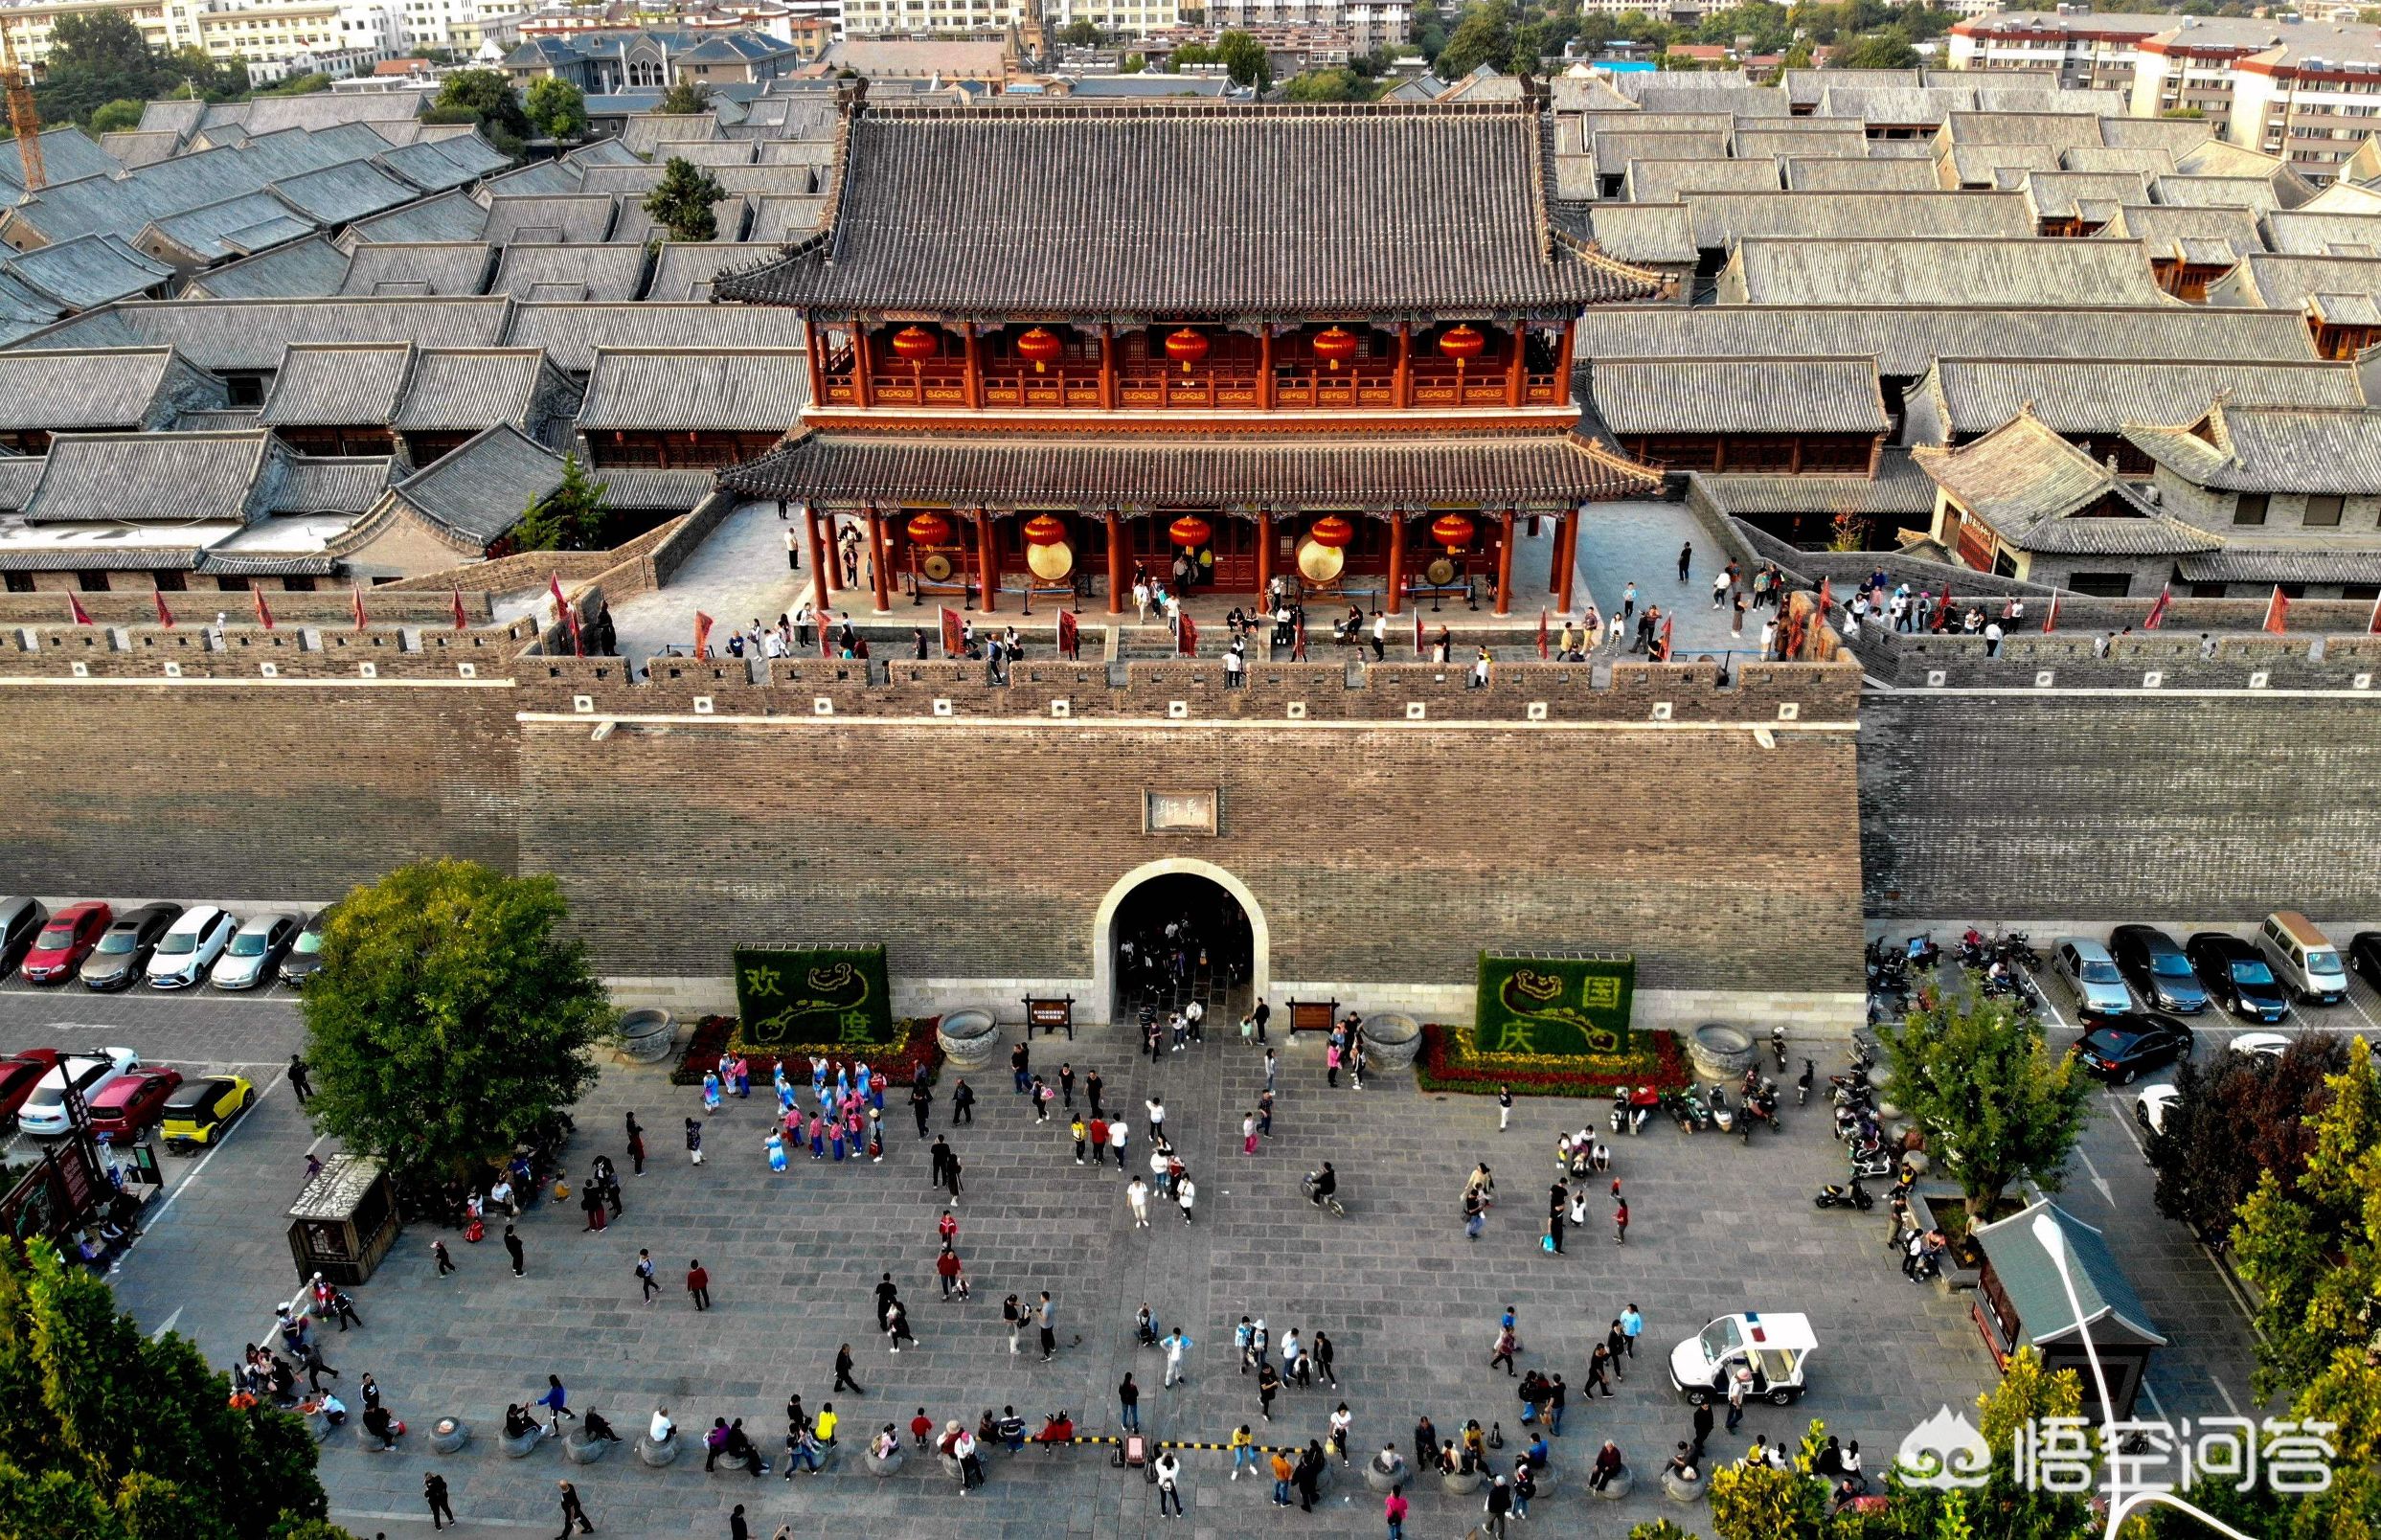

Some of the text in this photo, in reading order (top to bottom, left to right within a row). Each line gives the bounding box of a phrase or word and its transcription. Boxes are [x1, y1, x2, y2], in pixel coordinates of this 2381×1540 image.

[744, 964, 874, 1043] 欢 度
[1496, 976, 1621, 1053] 国 庆
